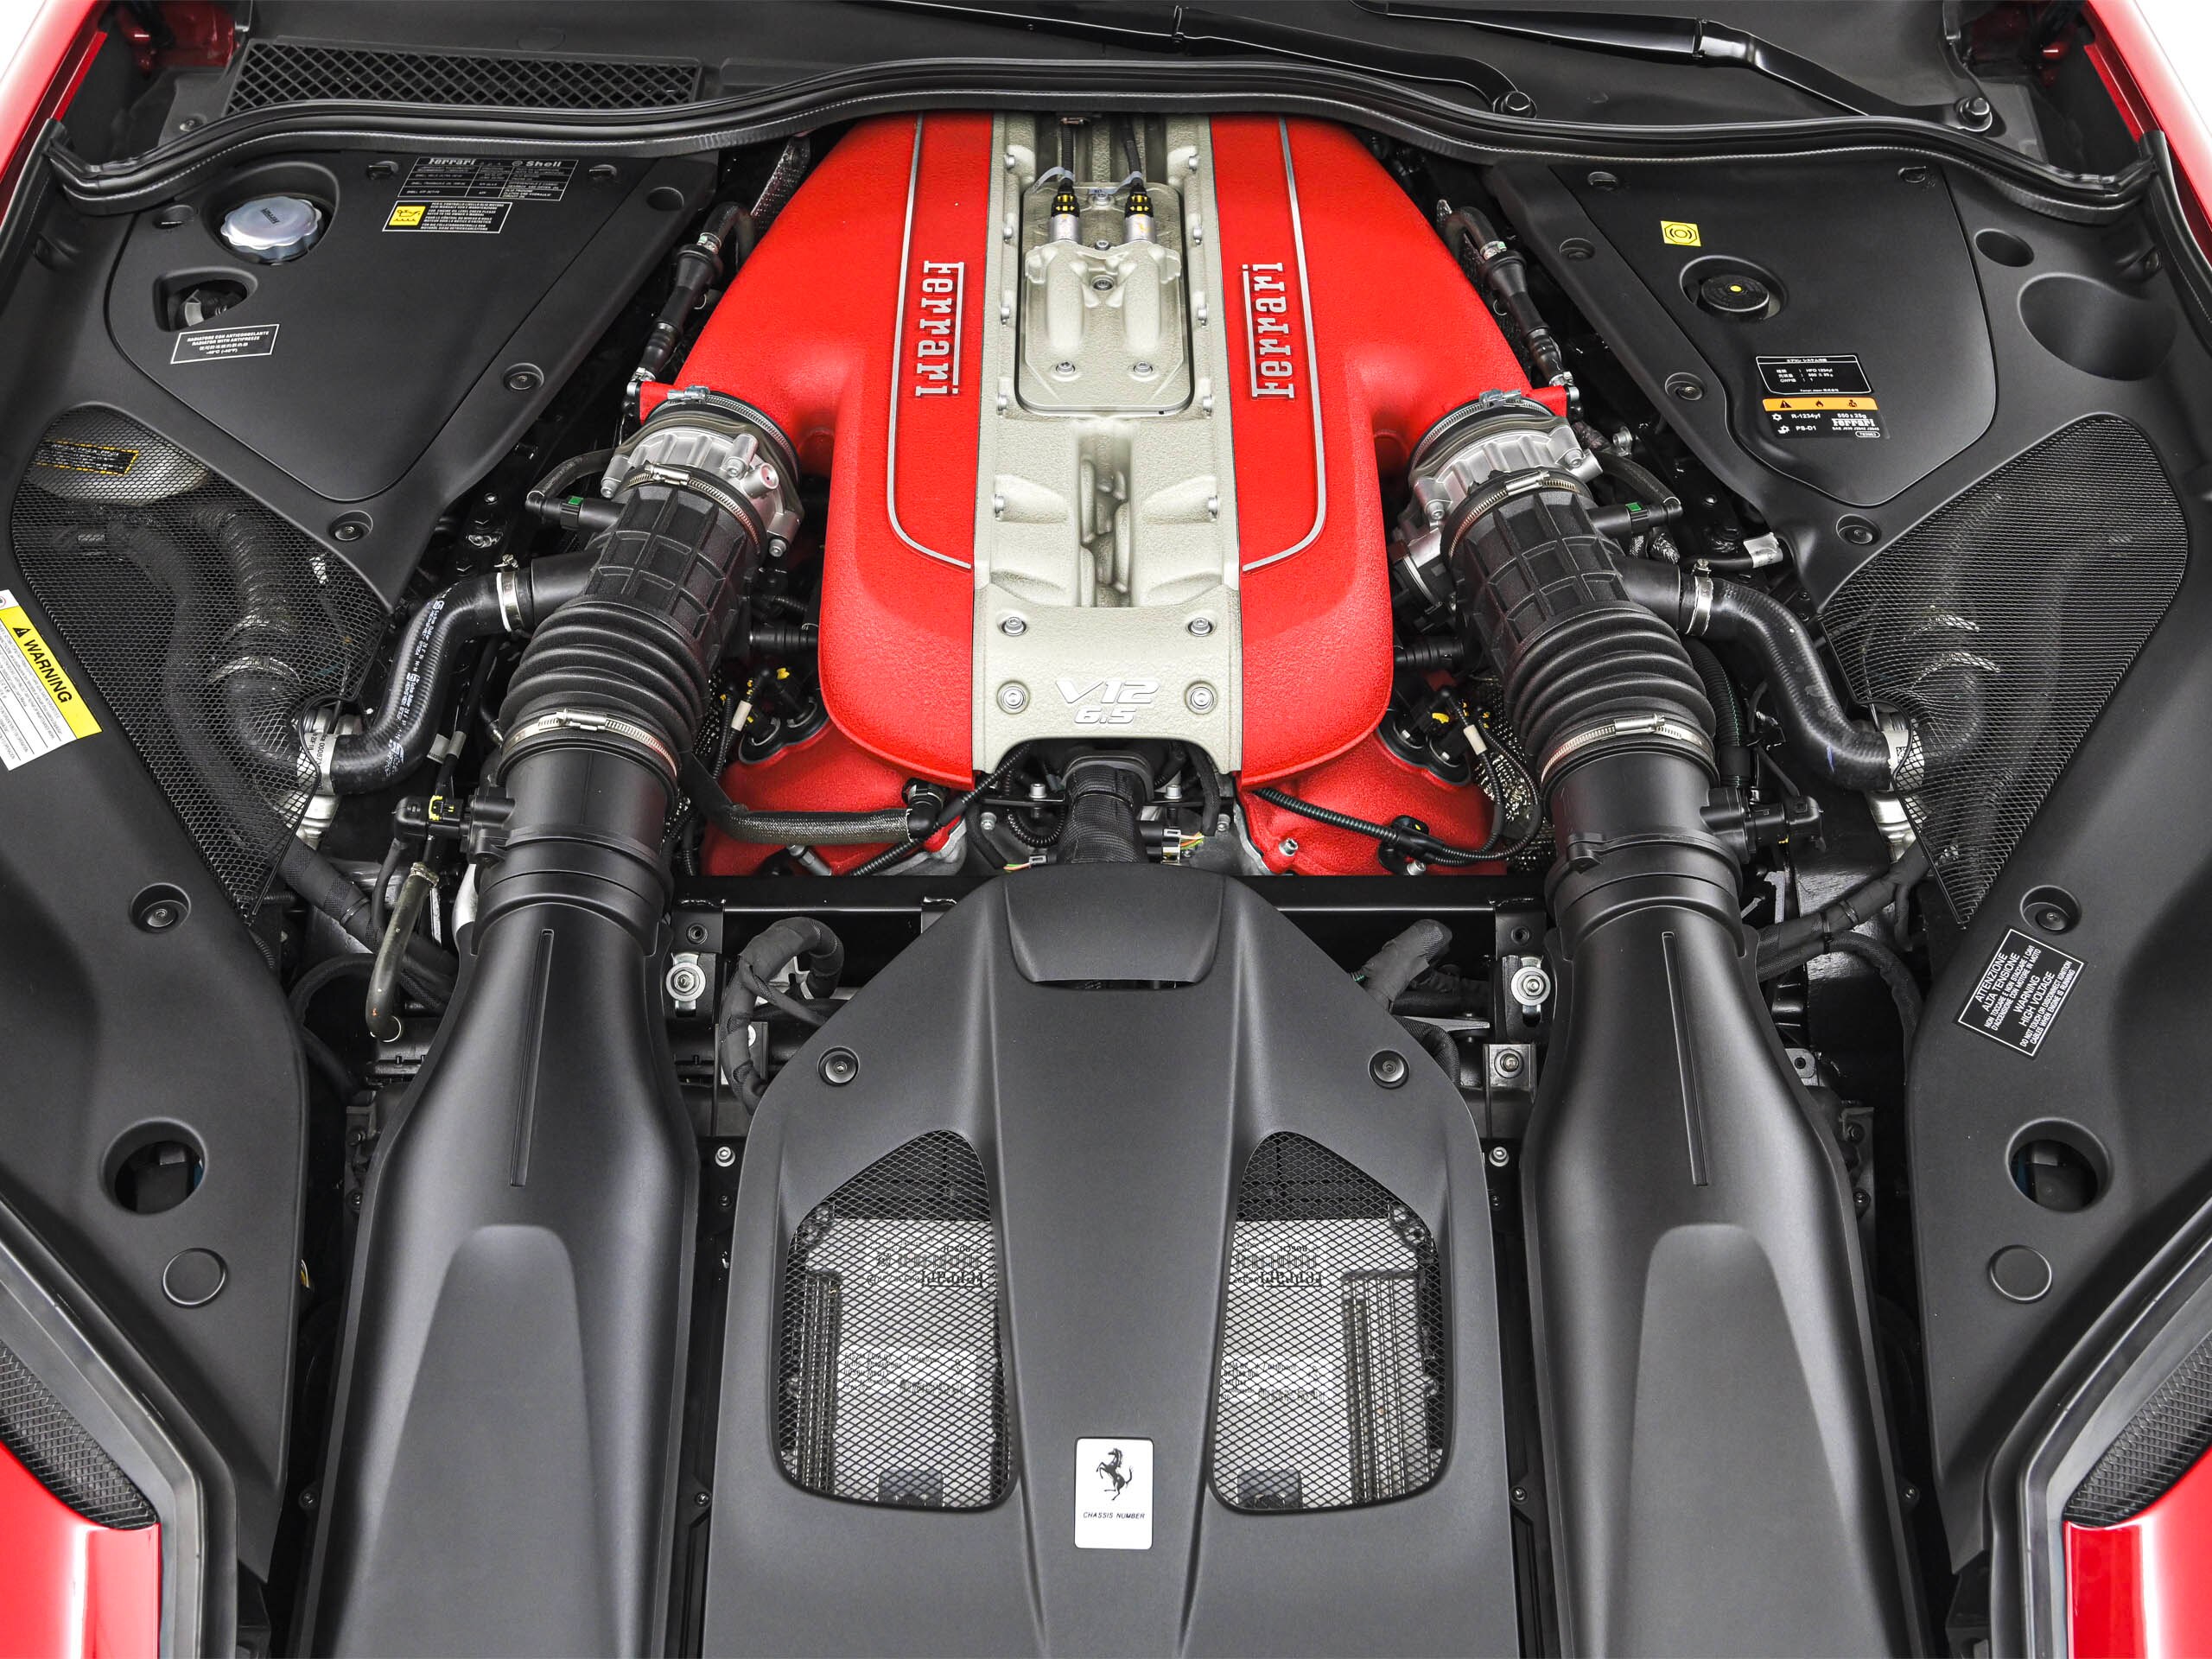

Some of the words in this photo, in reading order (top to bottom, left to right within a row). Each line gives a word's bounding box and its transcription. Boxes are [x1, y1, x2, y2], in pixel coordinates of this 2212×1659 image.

[915, 261, 964, 397] Ferrari
[1242, 262, 1294, 399] Ferrari
[24, 639, 72, 702] WARNING
[1055, 678, 1161, 704] V12
[1074, 707, 1137, 724] 6.5
[1975, 952, 2008, 1002] ATTENZIONE
[1982, 993, 1998, 1012] ALTA
[1992, 952, 2020, 991] TENSIONE
[1984, 1016, 1995, 1028] NON
[1990, 995, 2006, 1016] TOCCARE
[2005, 981, 2015, 992] NON
[2011, 958, 2027, 982] STACCARE
[2024, 945, 2035, 956] CAVI
[1991, 998, 2013, 1031] D'ACCENSIONE
[2009, 988, 2019, 999] CON
[2015, 968, 2031, 988] MOTORE
[2029, 949, 2041, 963] MOTO
[2013, 975, 2040, 1013] WARNING
[2042, 979, 2061, 1007] DISCONNECT
[2056, 960, 2072, 981] IGNITION
[2018, 1005, 2036, 1027] HIGH
[2030, 971, 2055, 1004] VOLTAGE
[2029, 1014, 2043, 1029] TOUCH
[2030, 1027, 2044, 1044] CABLES
[2039, 1012, 2052, 1027] WHEN
[2047, 995, 2061, 1013] ENGINE
[2060, 969, 2075, 990] RUNNING
[2020, 1039, 2029, 1047] DO
[2024, 1028, 2034, 1039] NOT
